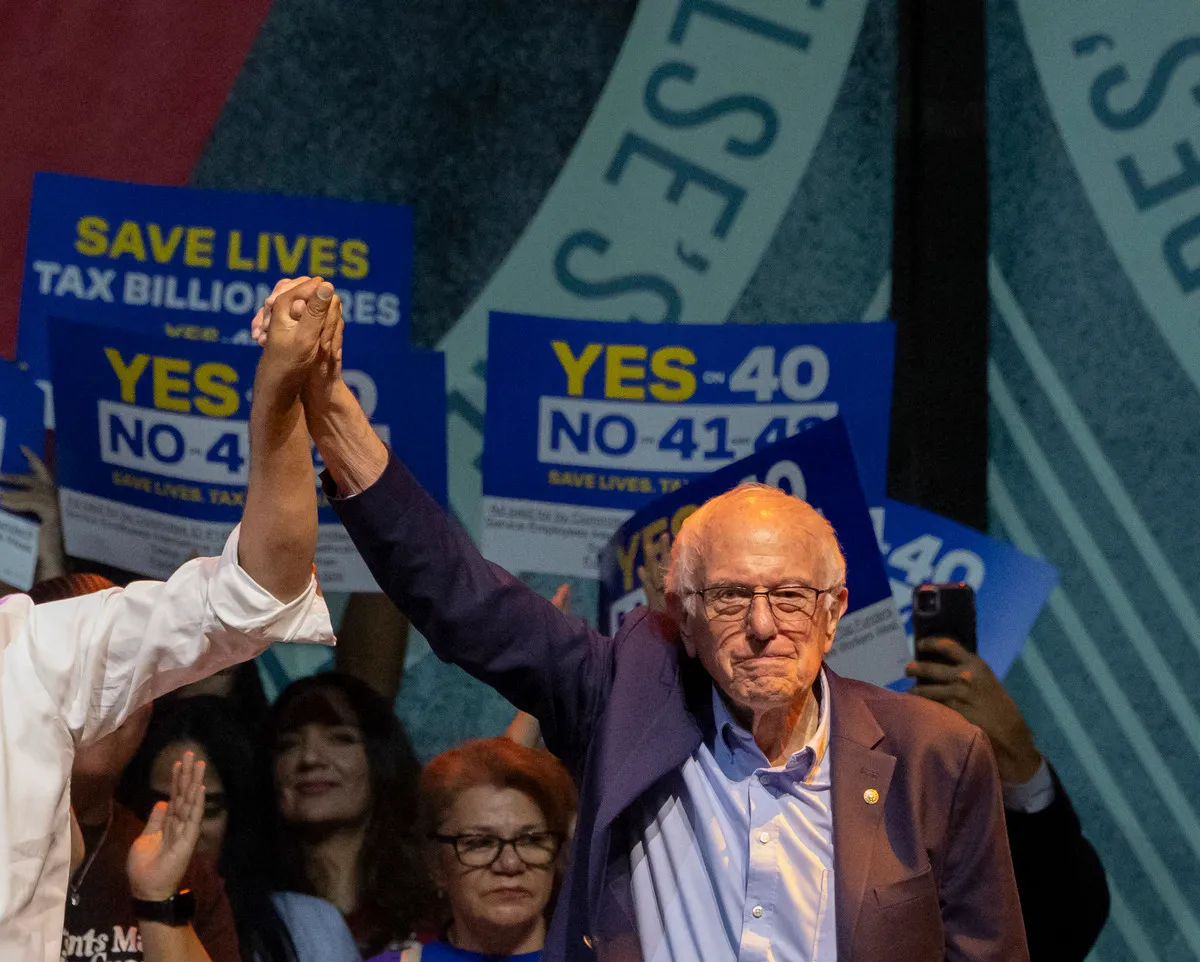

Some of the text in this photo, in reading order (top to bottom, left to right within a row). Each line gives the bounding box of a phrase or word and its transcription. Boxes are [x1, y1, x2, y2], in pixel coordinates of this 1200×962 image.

[551, 0, 814, 323] LSE'S
[75, 215, 371, 280] SAVE LIVES
[32, 260, 401, 327] TAX BILLIORES
[103, 347, 241, 418] YES
[550, 340, 698, 403] YES
[729, 344, 831, 403] 40
[108, 414, 245, 474] NO 4
[549, 411, 637, 457] NO
[658, 416, 735, 461] 41
[547, 469, 596, 490] SAVE
